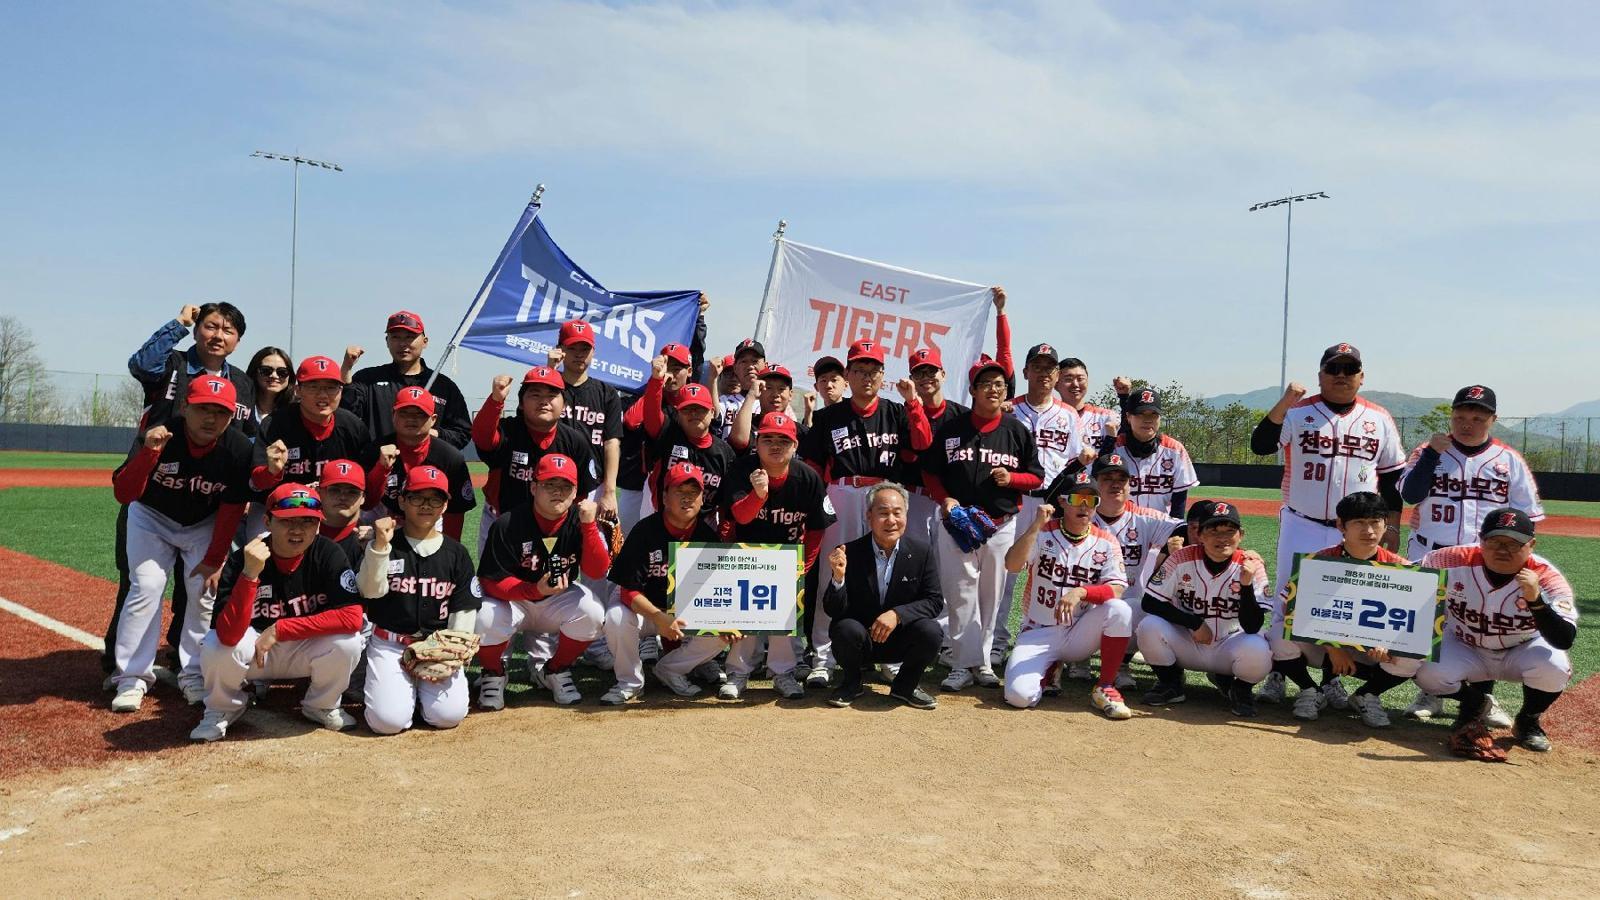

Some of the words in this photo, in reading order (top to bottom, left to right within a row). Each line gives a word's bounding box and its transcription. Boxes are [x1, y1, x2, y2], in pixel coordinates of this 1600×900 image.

[859, 280, 911, 304] EAST
[516, 263, 666, 363] TIGERS
[809, 298, 952, 360] TIGERS
[834, 435, 862, 455] East
[866, 432, 899, 449] Tigers
[1298, 430, 1380, 462] 천하무적
[880, 450, 897, 467] 47
[945, 447, 974, 464] East
[979, 447, 1019, 469] Tigers
[1303, 462, 1326, 481] 20
[1129, 474, 1175, 496] 하무적
[1429, 473, 1509, 505] 천하무적
[1431, 503, 1456, 524] 50
[713, 587, 733, 597] 지적
[737, 579, 778, 611] 1위
[1036, 585, 1057, 609] 93
[1310, 607, 1353, 621] 어울림부
[1332, 599, 1354, 611] 지적
[1358, 599, 1416, 633] 2위
